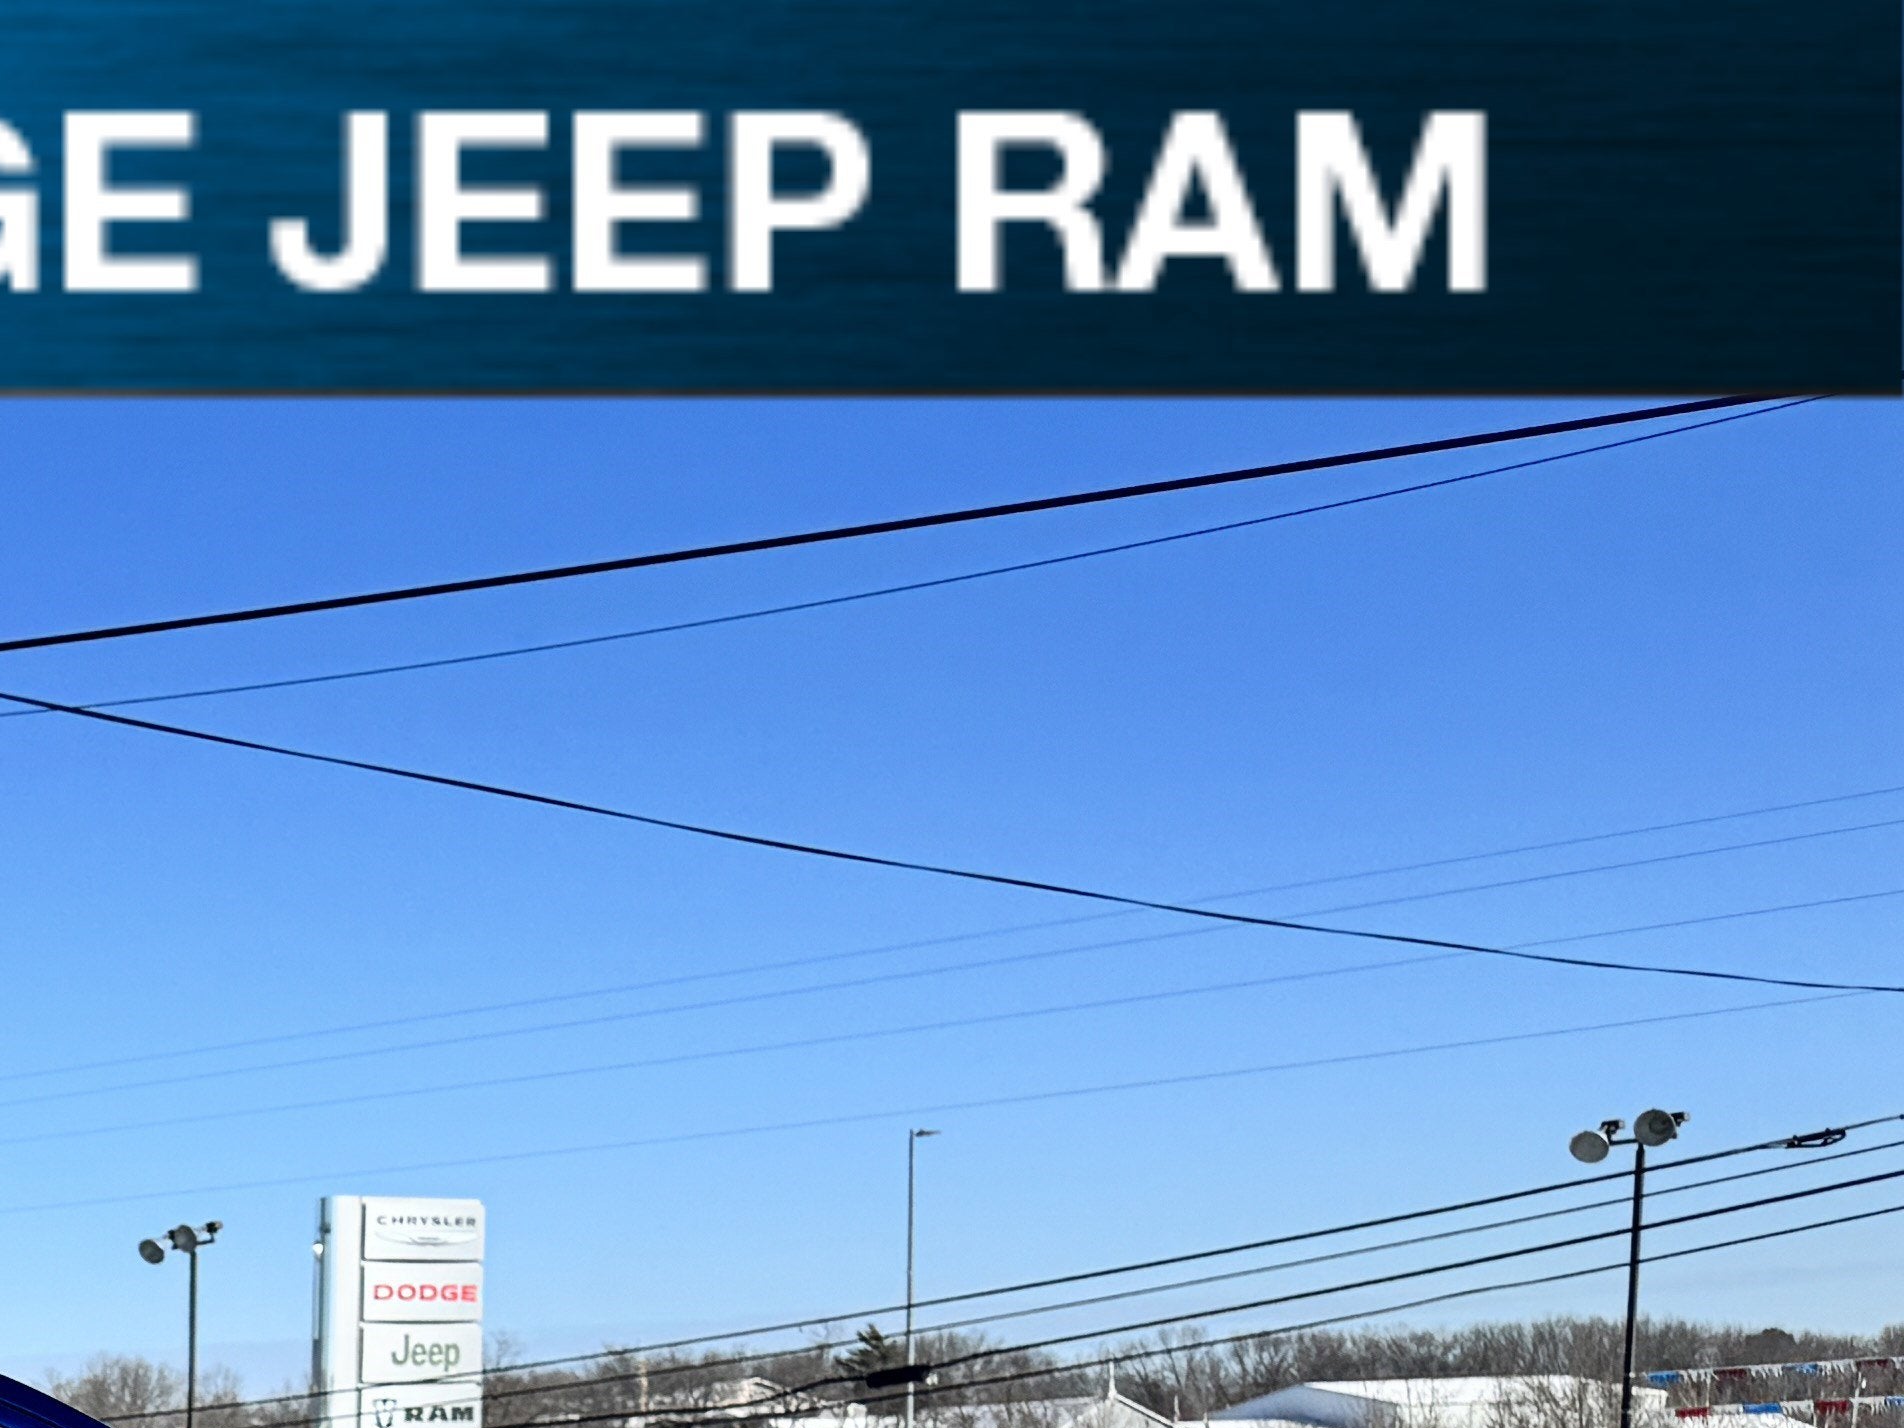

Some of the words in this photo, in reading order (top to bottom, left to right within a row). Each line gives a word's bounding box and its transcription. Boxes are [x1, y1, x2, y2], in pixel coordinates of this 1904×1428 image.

[376, 1214, 477, 1227] CHRYSLER
[373, 1283, 478, 1303] DODGE
[391, 1333, 461, 1372] Jeep
[403, 1405, 475, 1423] RAM
